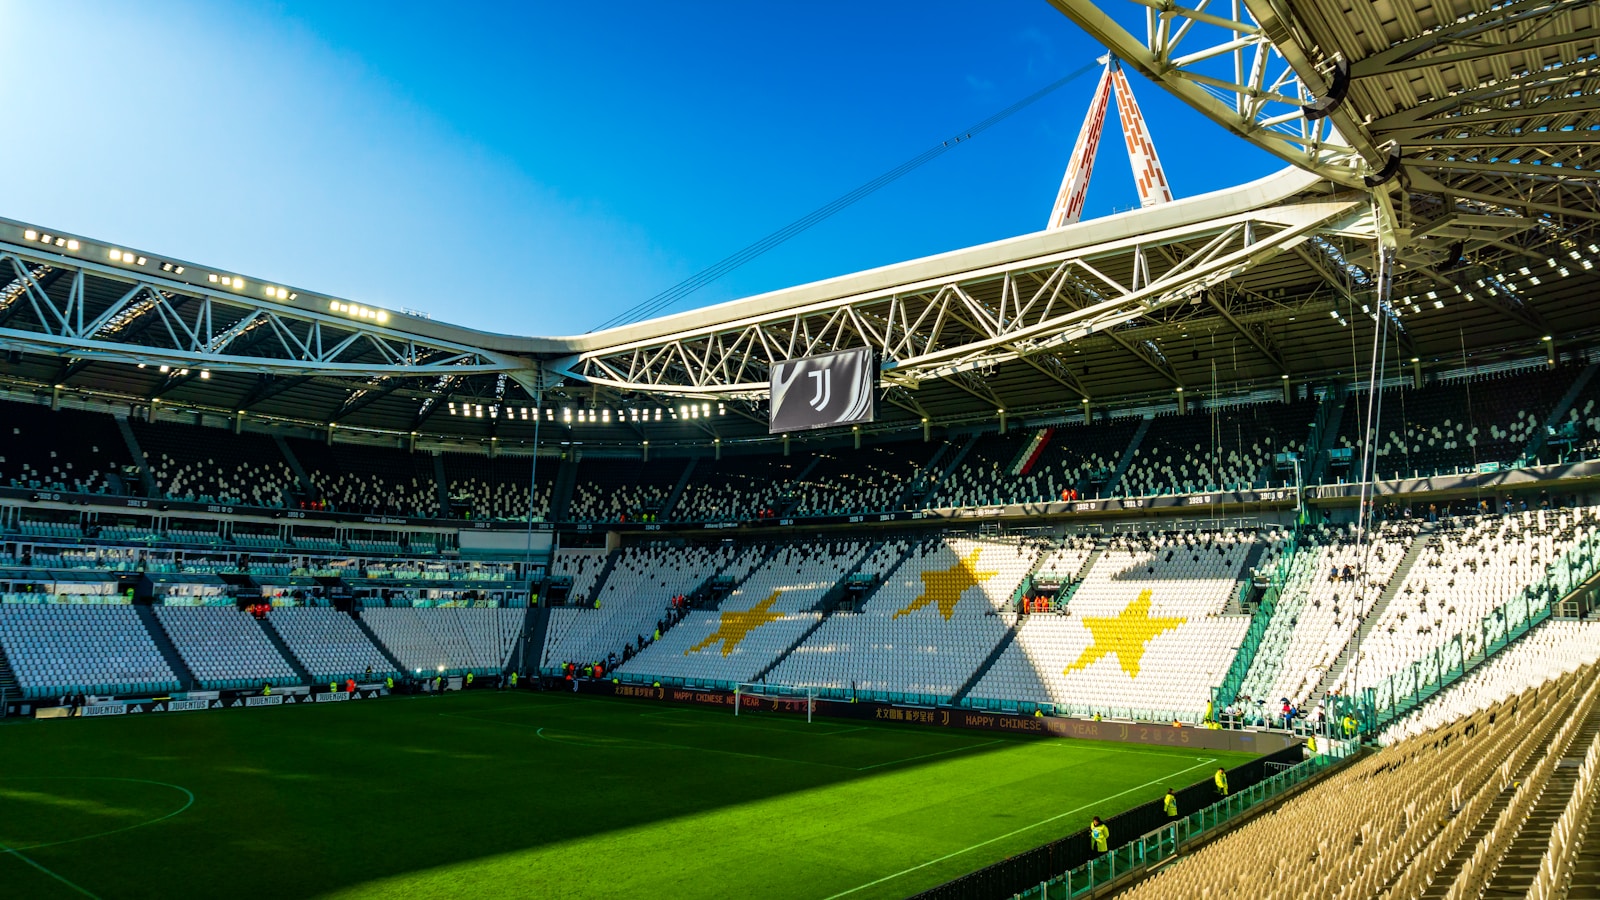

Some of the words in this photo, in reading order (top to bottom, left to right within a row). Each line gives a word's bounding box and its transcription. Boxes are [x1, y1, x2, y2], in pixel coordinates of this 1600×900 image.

[249, 696, 280, 705] JUVENTUS
[673, 690, 693, 701] HAPPY
[695, 693, 724, 704] CHINESE
[726, 695, 739, 705] NE
[743, 697, 760, 707] YEAR
[86, 705, 123, 715] JUVENTUS
[172, 700, 206, 710] JUVENTUS
[965, 715, 995, 727] HAPPY
[999, 717, 1042, 731] CHINESE
[1047, 721, 1066, 733] NEW
[1072, 723, 1098, 735] YEAR
